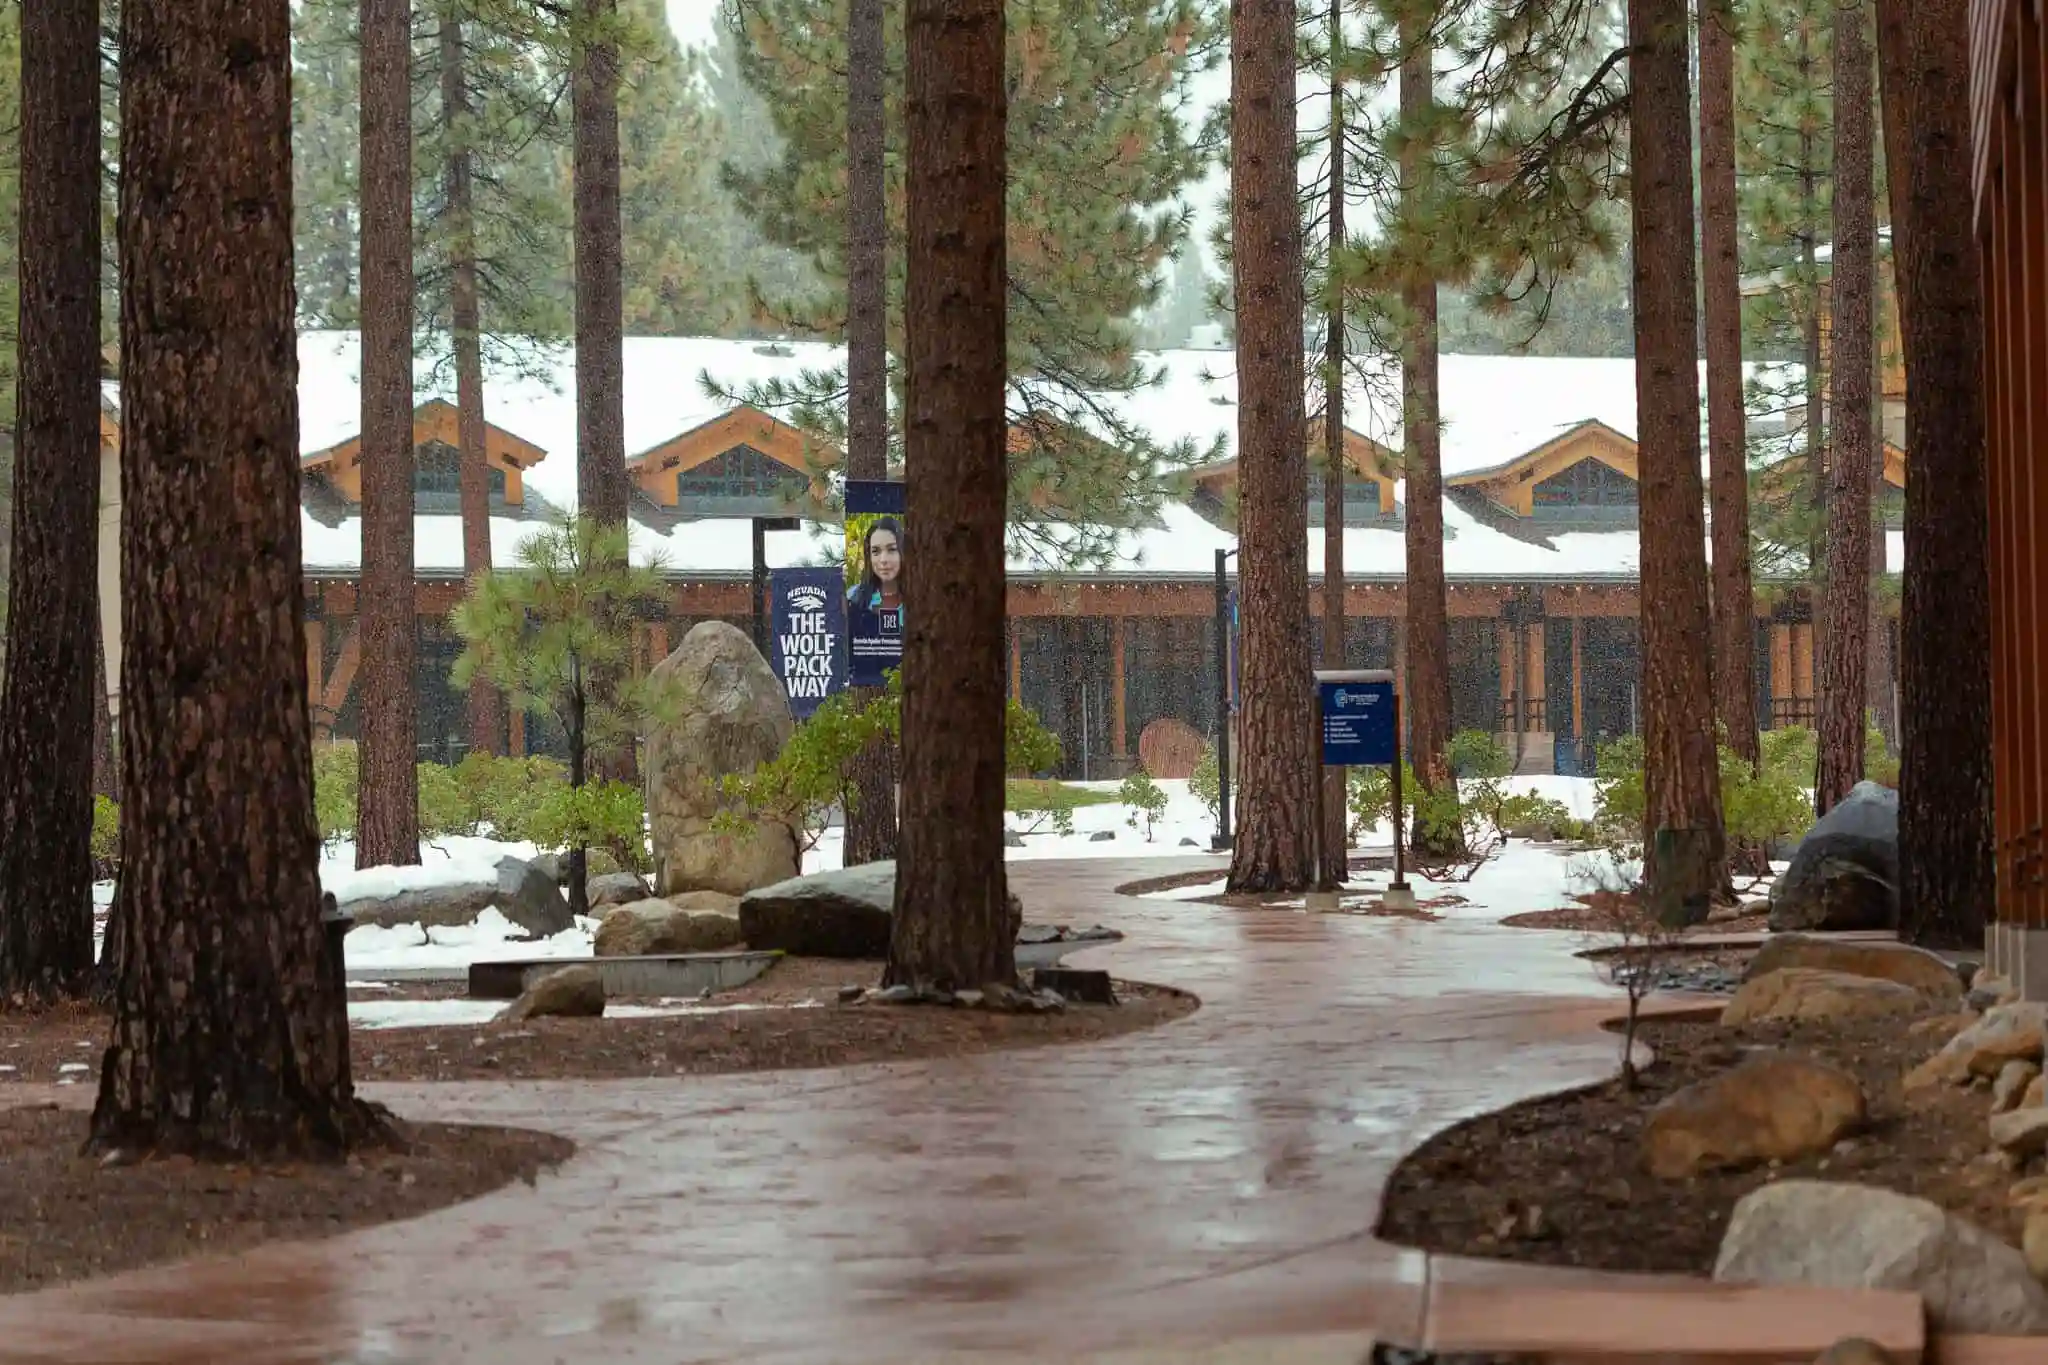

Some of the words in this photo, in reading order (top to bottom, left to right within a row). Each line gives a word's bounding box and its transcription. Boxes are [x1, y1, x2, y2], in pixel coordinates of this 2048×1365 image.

[787, 586, 827, 600] NEVADA
[788, 613, 826, 633] THE
[780, 634, 835, 655] WOLF
[784, 655, 833, 676] PACK
[787, 677, 831, 697] WAY
